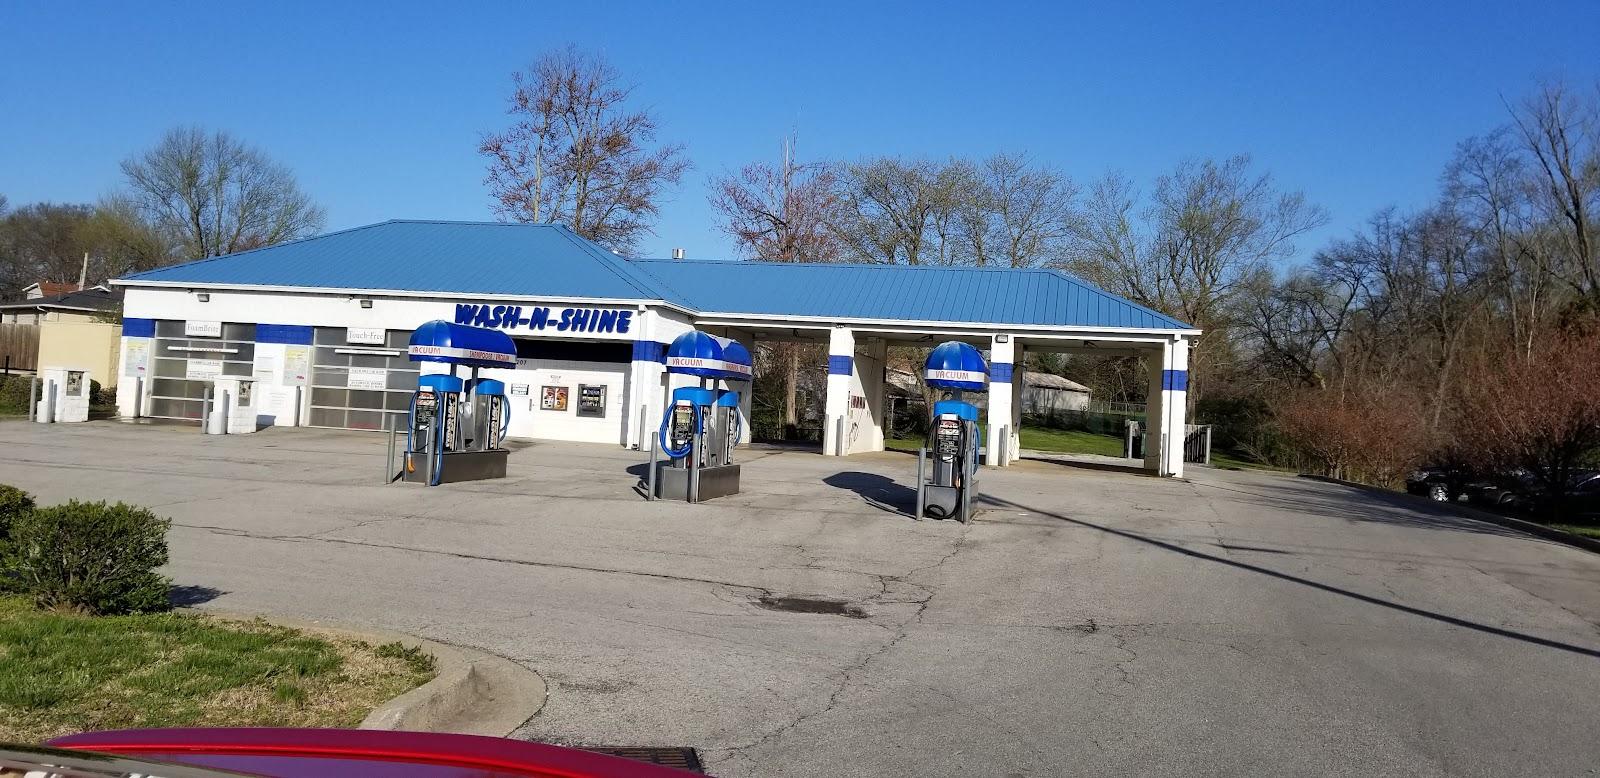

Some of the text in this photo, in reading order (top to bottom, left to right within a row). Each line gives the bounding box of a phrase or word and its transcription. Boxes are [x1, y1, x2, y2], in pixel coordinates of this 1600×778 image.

[455, 304, 632, 333] WASH-N-SHINE
[349, 330, 384, 340] Touch-Free
[413, 346, 441, 355] VACUUM
[672, 358, 703, 367] VACUUM
[935, 370, 969, 380] VACUUM
